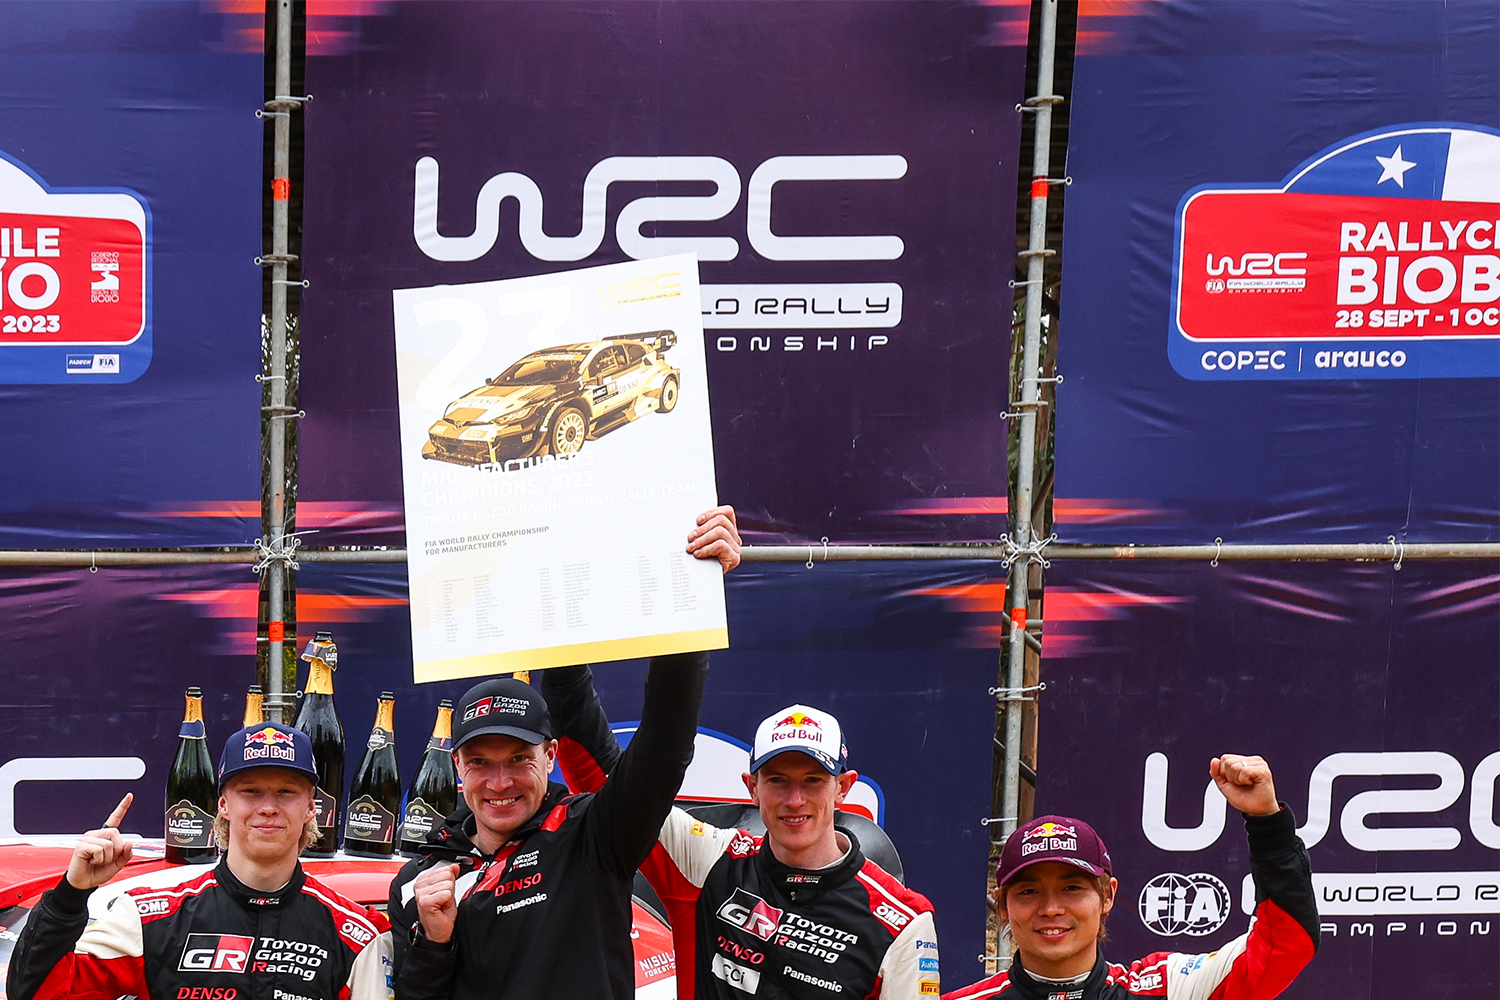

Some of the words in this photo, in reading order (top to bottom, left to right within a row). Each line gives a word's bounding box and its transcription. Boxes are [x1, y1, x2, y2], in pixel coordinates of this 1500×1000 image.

[414, 155, 908, 262] WRC
[1207, 252, 1307, 275] WRC
[754, 297, 889, 314] RALLY
[3, 316, 60, 333] 2023
[1335, 310, 1364, 328] 28
[1368, 309, 1430, 328] SEPT
[1201, 350, 1286, 370] COPEC
[1314, 350, 1407, 368] arauco
[422, 478, 540, 508] CHAMPIONS
[546, 470, 596, 492] 2023
[423, 510, 471, 527] TOYOTA
[519, 499, 566, 514] RACING
[569, 492, 615, 508] WORLD
[618, 486, 657, 501] RALLY
[659, 481, 697, 496] TEAM
[425, 540, 437, 548] FIA
[438, 536, 465, 546] WORLD
[467, 533, 490, 542] RALLY
[491, 526, 549, 539] CHAMPIONSHIP
[425, 548, 440, 556] FOR
[441, 540, 507, 554] MANUFACTURERS
[493, 702, 527, 710] GAZOO
[495, 696, 529, 706] TOYOTA
[463, 703, 490, 721] GR
[492, 708, 526, 716] Racing
[772, 729, 796, 743] Red
[798, 729, 822, 743] Bull
[244, 744, 269, 762] Red
[270, 745, 295, 762] Bull
[169, 817, 203, 829] WRC
[350, 811, 382, 822] WRC
[1022, 837, 1048, 856] Red
[1049, 837, 1078, 852] Bull
[494, 872, 542, 897] DENSO
[1324, 885, 1460, 902] WORLD
[138, 900, 170, 913] OMP
[496, 893, 548, 915] Panasonic
[720, 903, 776, 937] GR
[876, 905, 907, 926] OMP
[342, 921, 371, 942] OMP
[777, 924, 847, 952] GAZOO
[786, 913, 859, 945] TOYOTA
[255, 949, 321, 967] GAZOO
[259, 937, 328, 959] TOYOTA
[717, 935, 765, 964] DENSO
[773, 934, 840, 964] Racing
[183, 949, 246, 971] GR
[251, 961, 316, 981] Racing
[783, 966, 843, 993] Panasonic
[177, 987, 237, 1000] DENSO
